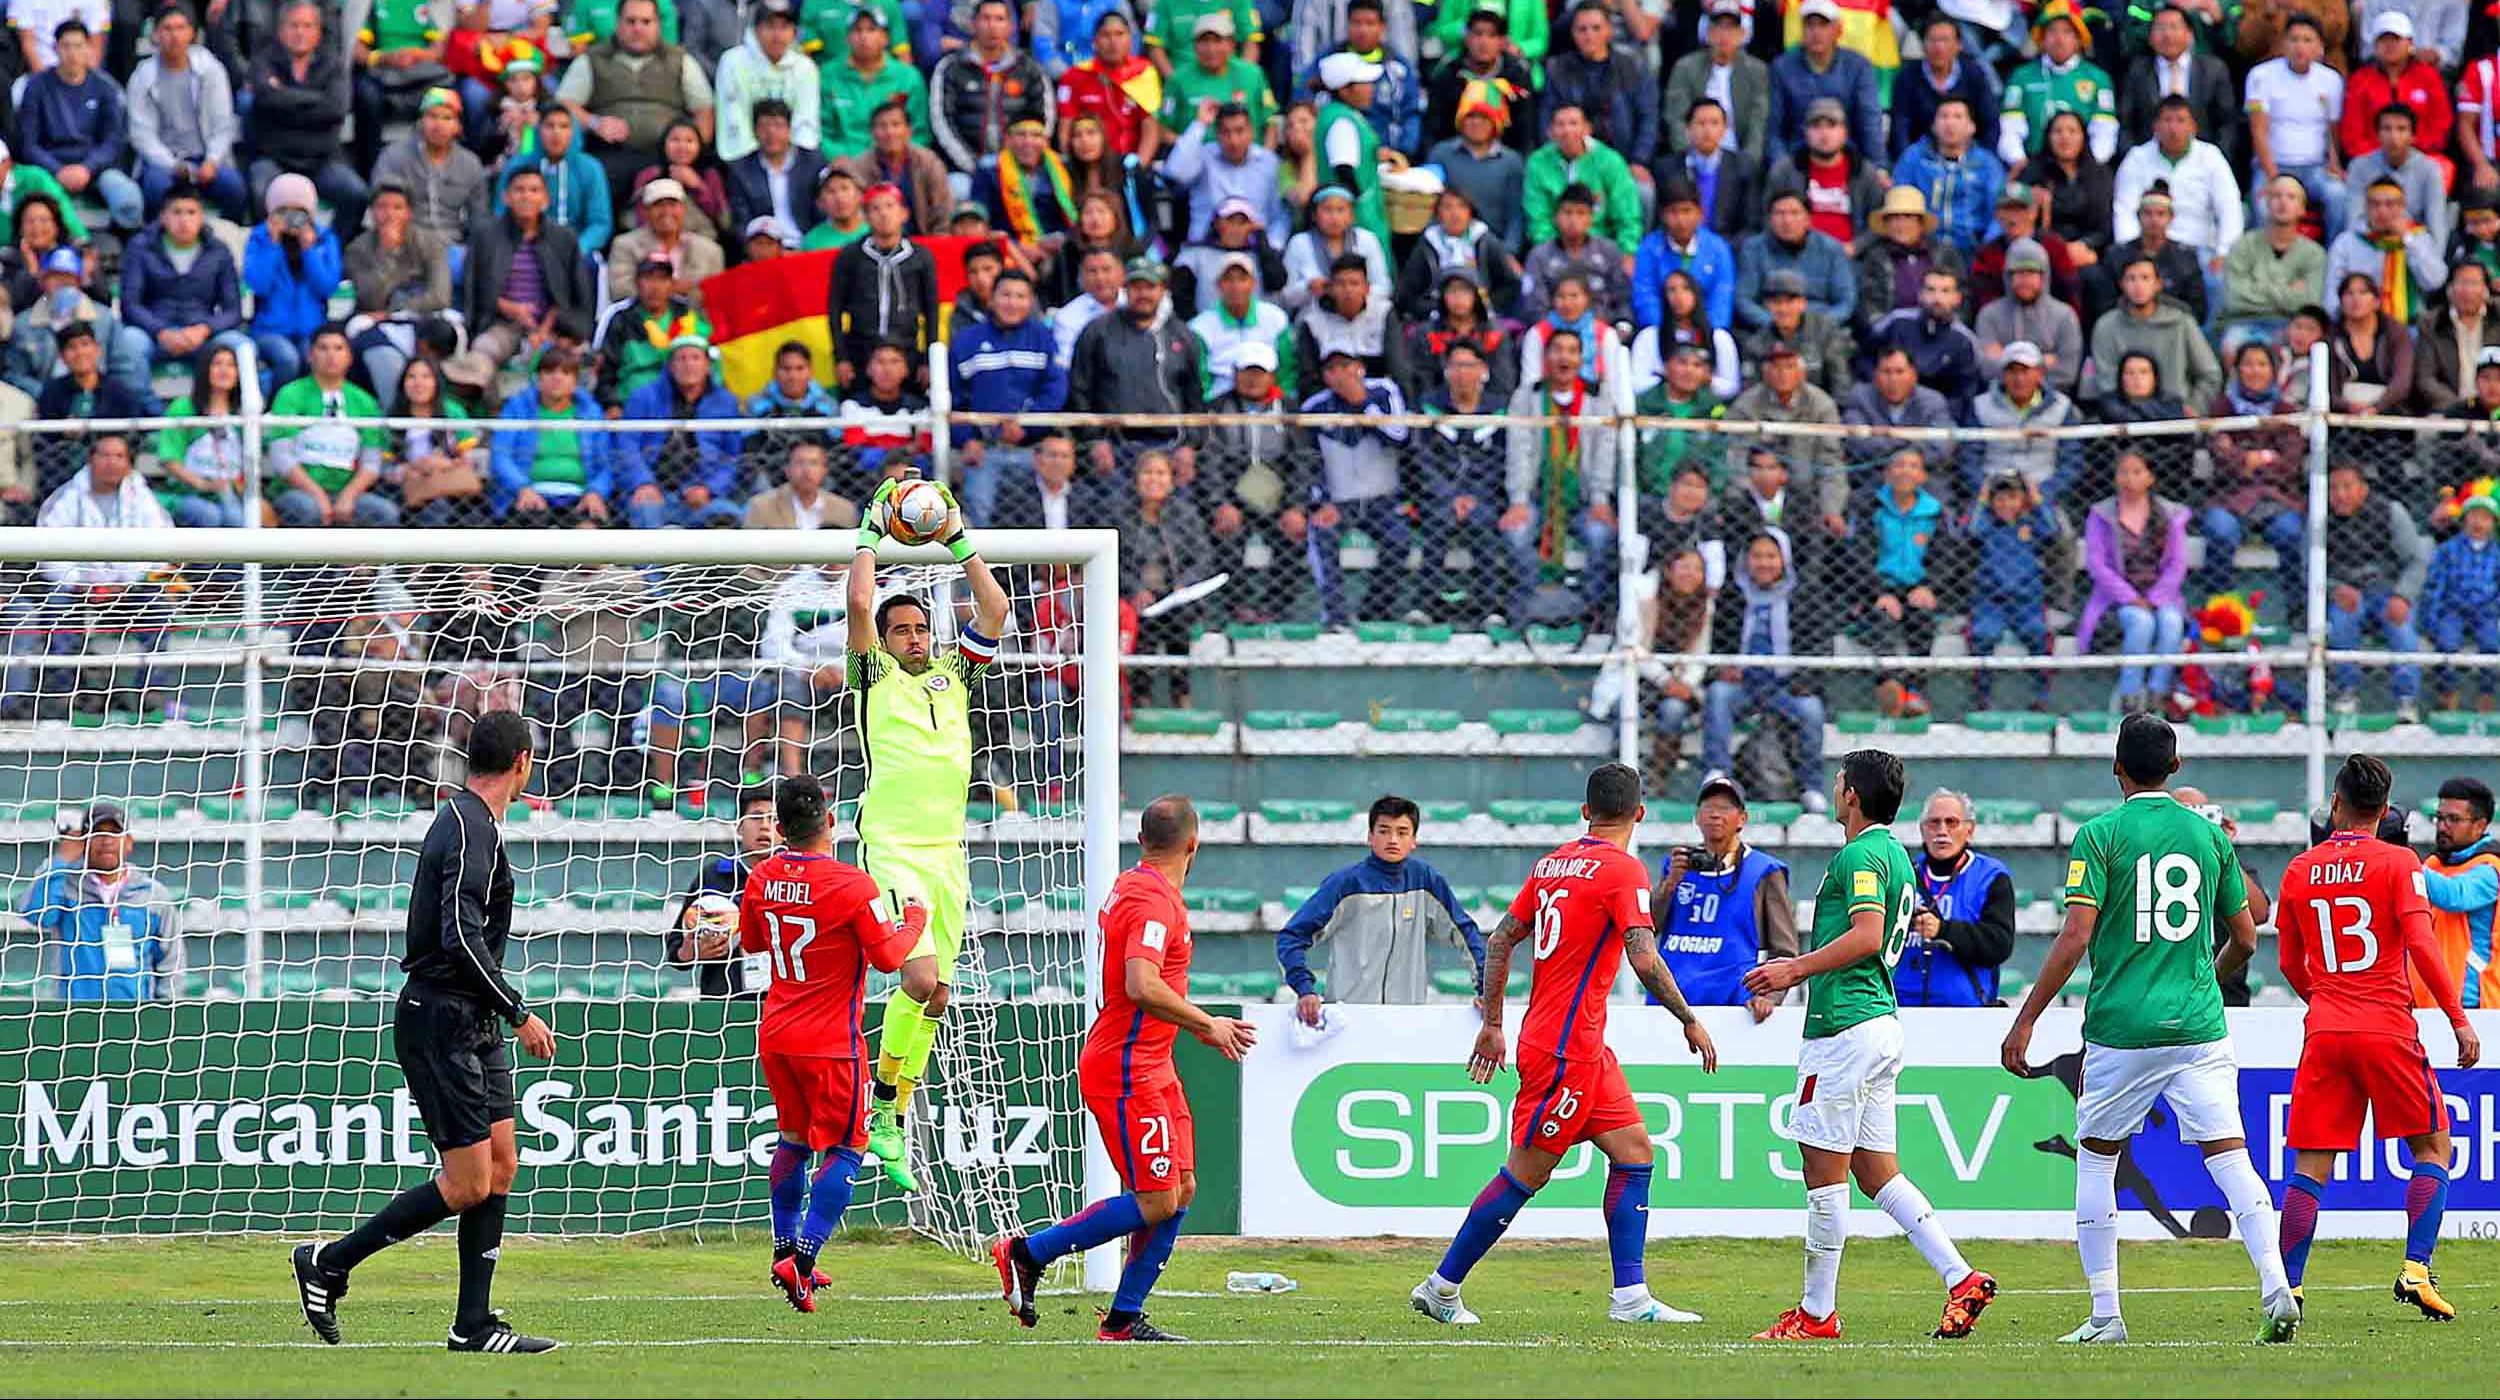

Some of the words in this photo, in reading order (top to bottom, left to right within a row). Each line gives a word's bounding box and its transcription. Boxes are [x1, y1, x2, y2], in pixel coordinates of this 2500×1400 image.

[763, 879, 814, 905] MEDEL
[887, 888, 900, 915] 1
[1534, 888, 1569, 961] 16
[1884, 882, 1915, 968] 8
[2135, 852, 2201, 943] 18
[764, 911, 817, 982] 17
[2309, 896, 2379, 973] 13
[24, 1080, 429, 1166] Mercant
[862, 1104, 1050, 1167] ruz
[1140, 1115, 1169, 1155] 21
[1550, 1086, 1583, 1119] 16
